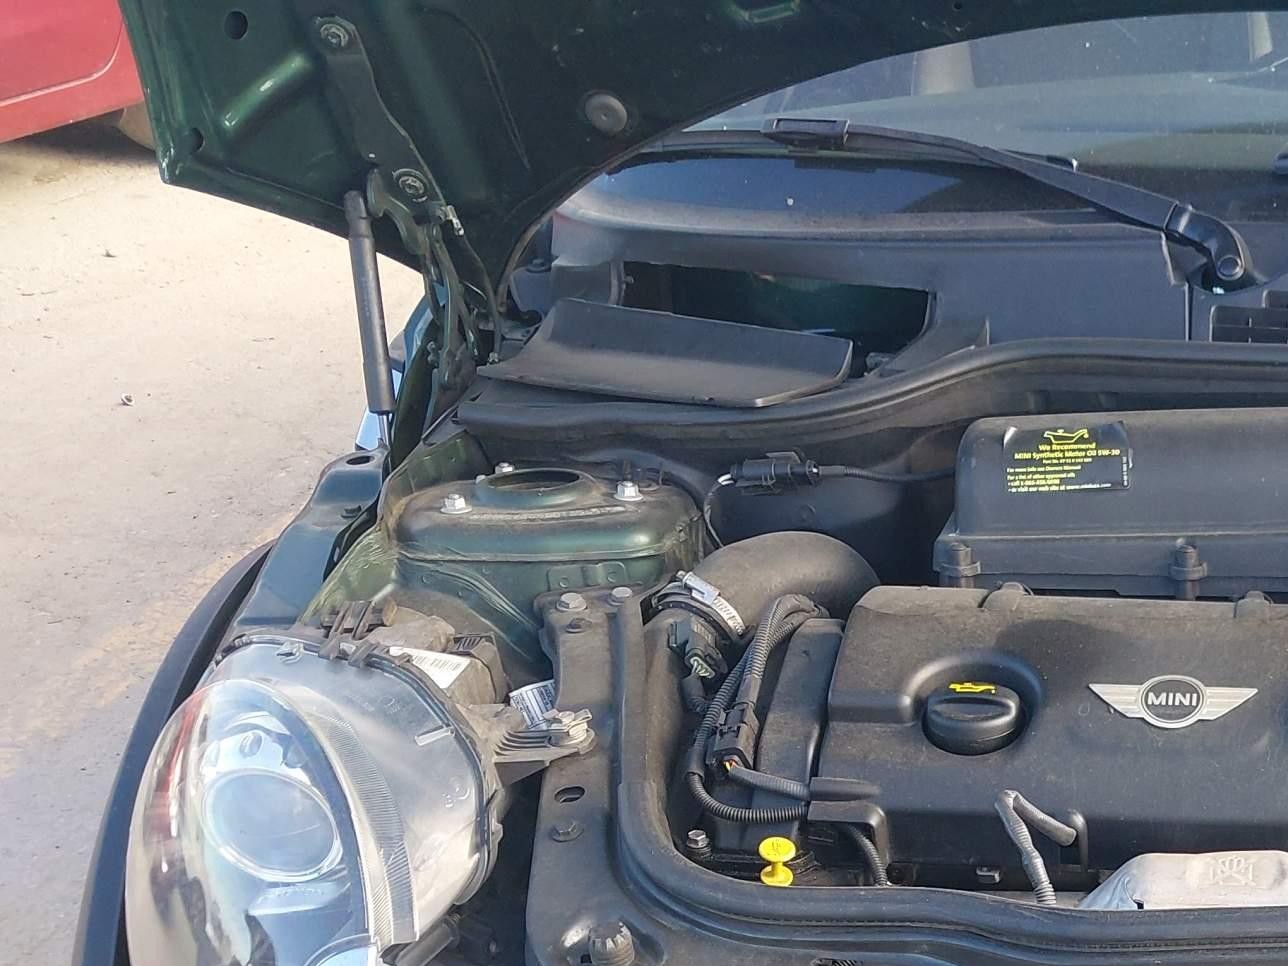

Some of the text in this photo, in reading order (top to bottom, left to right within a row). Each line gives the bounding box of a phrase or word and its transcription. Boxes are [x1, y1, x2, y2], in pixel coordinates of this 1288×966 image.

[1052, 442, 1096, 450] Recommend
[1014, 452, 1031, 460] MINI
[1032, 451, 1064, 461] Synthetic
[1147, 692, 1198, 707] MINI
